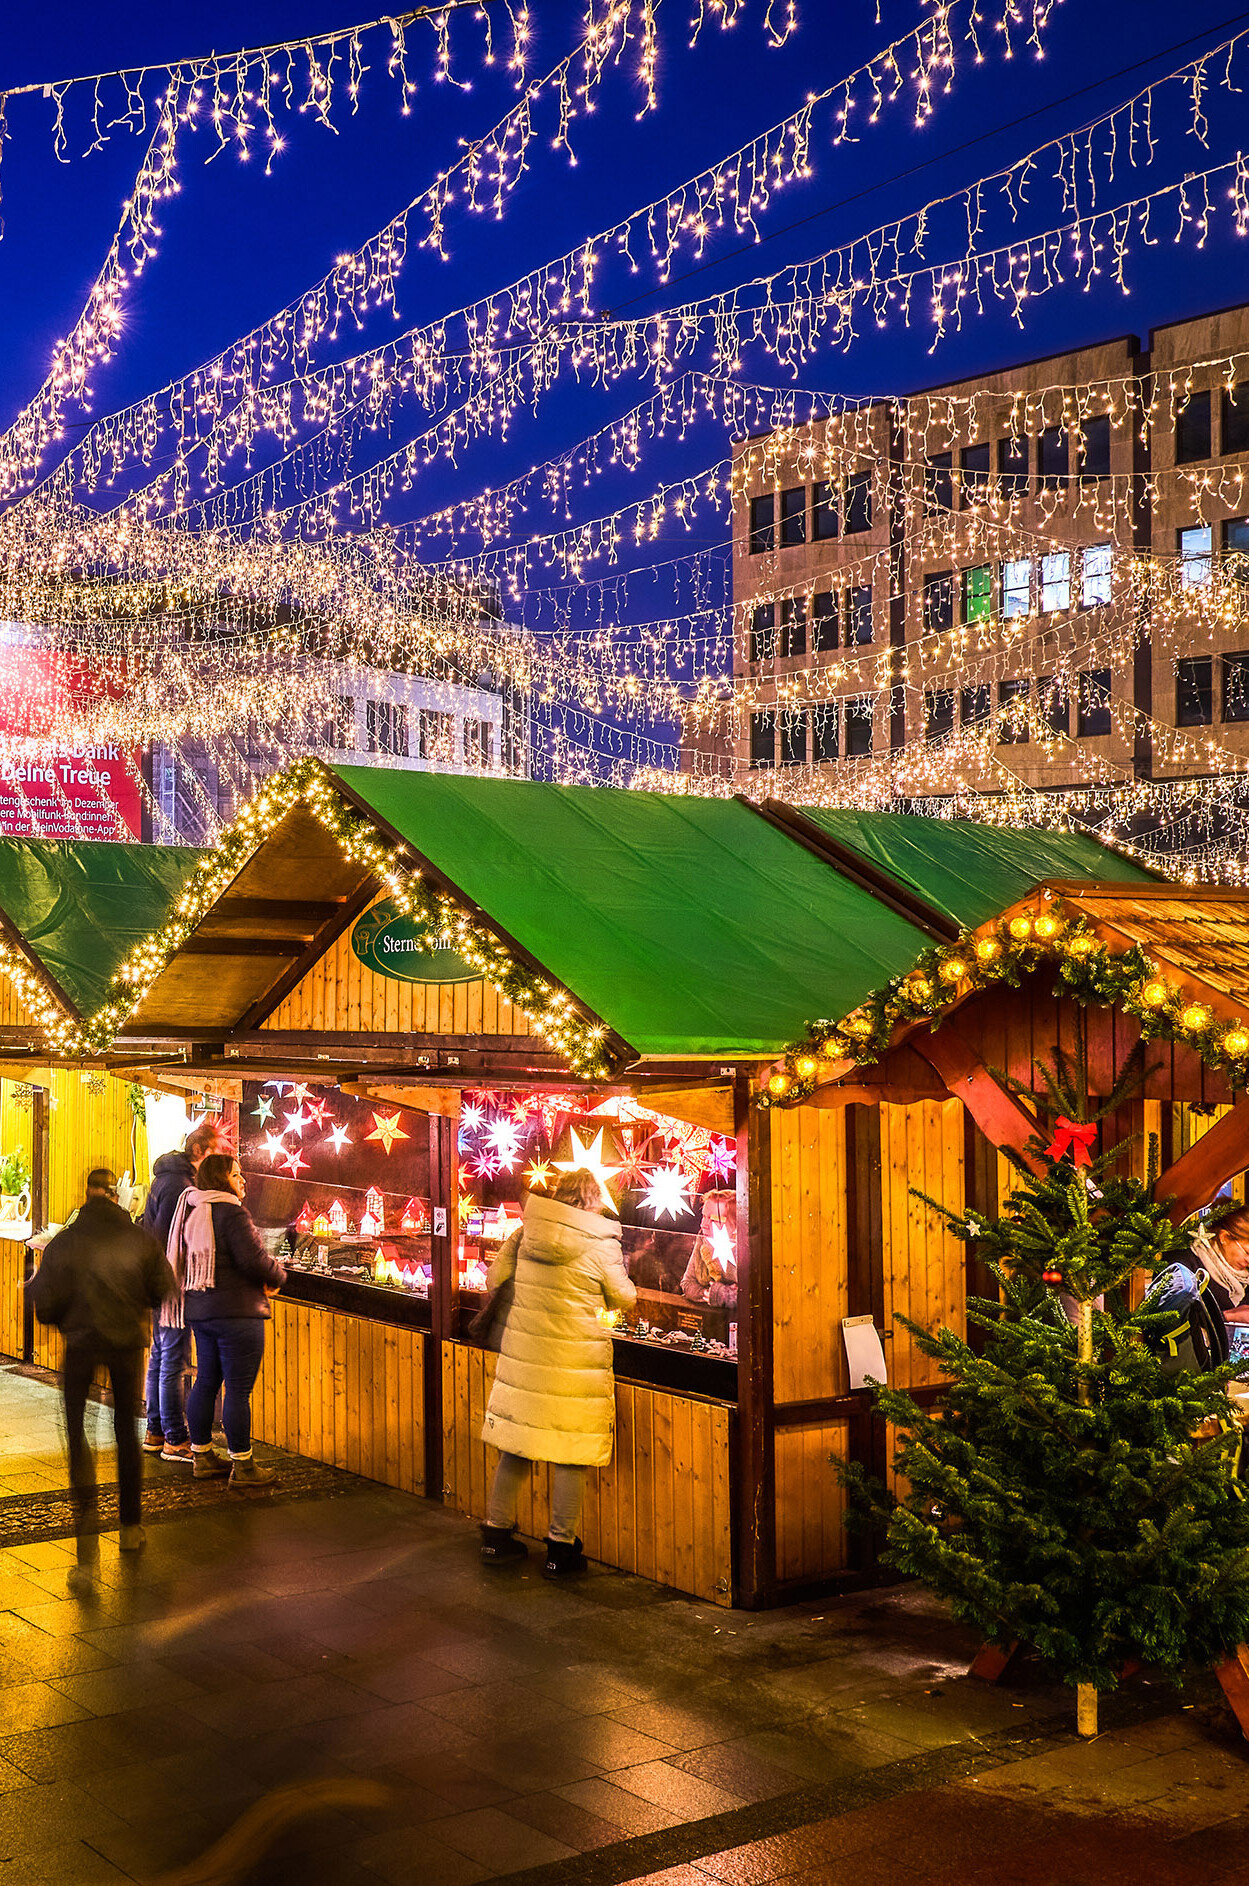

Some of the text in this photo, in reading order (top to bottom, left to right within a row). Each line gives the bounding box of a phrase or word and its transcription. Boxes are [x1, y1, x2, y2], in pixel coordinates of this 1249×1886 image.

[71, 740, 119, 760] Dank
[1, 763, 57, 784] Deine
[59, 765, 111, 785] Treue
[15, 821, 30, 832] der
